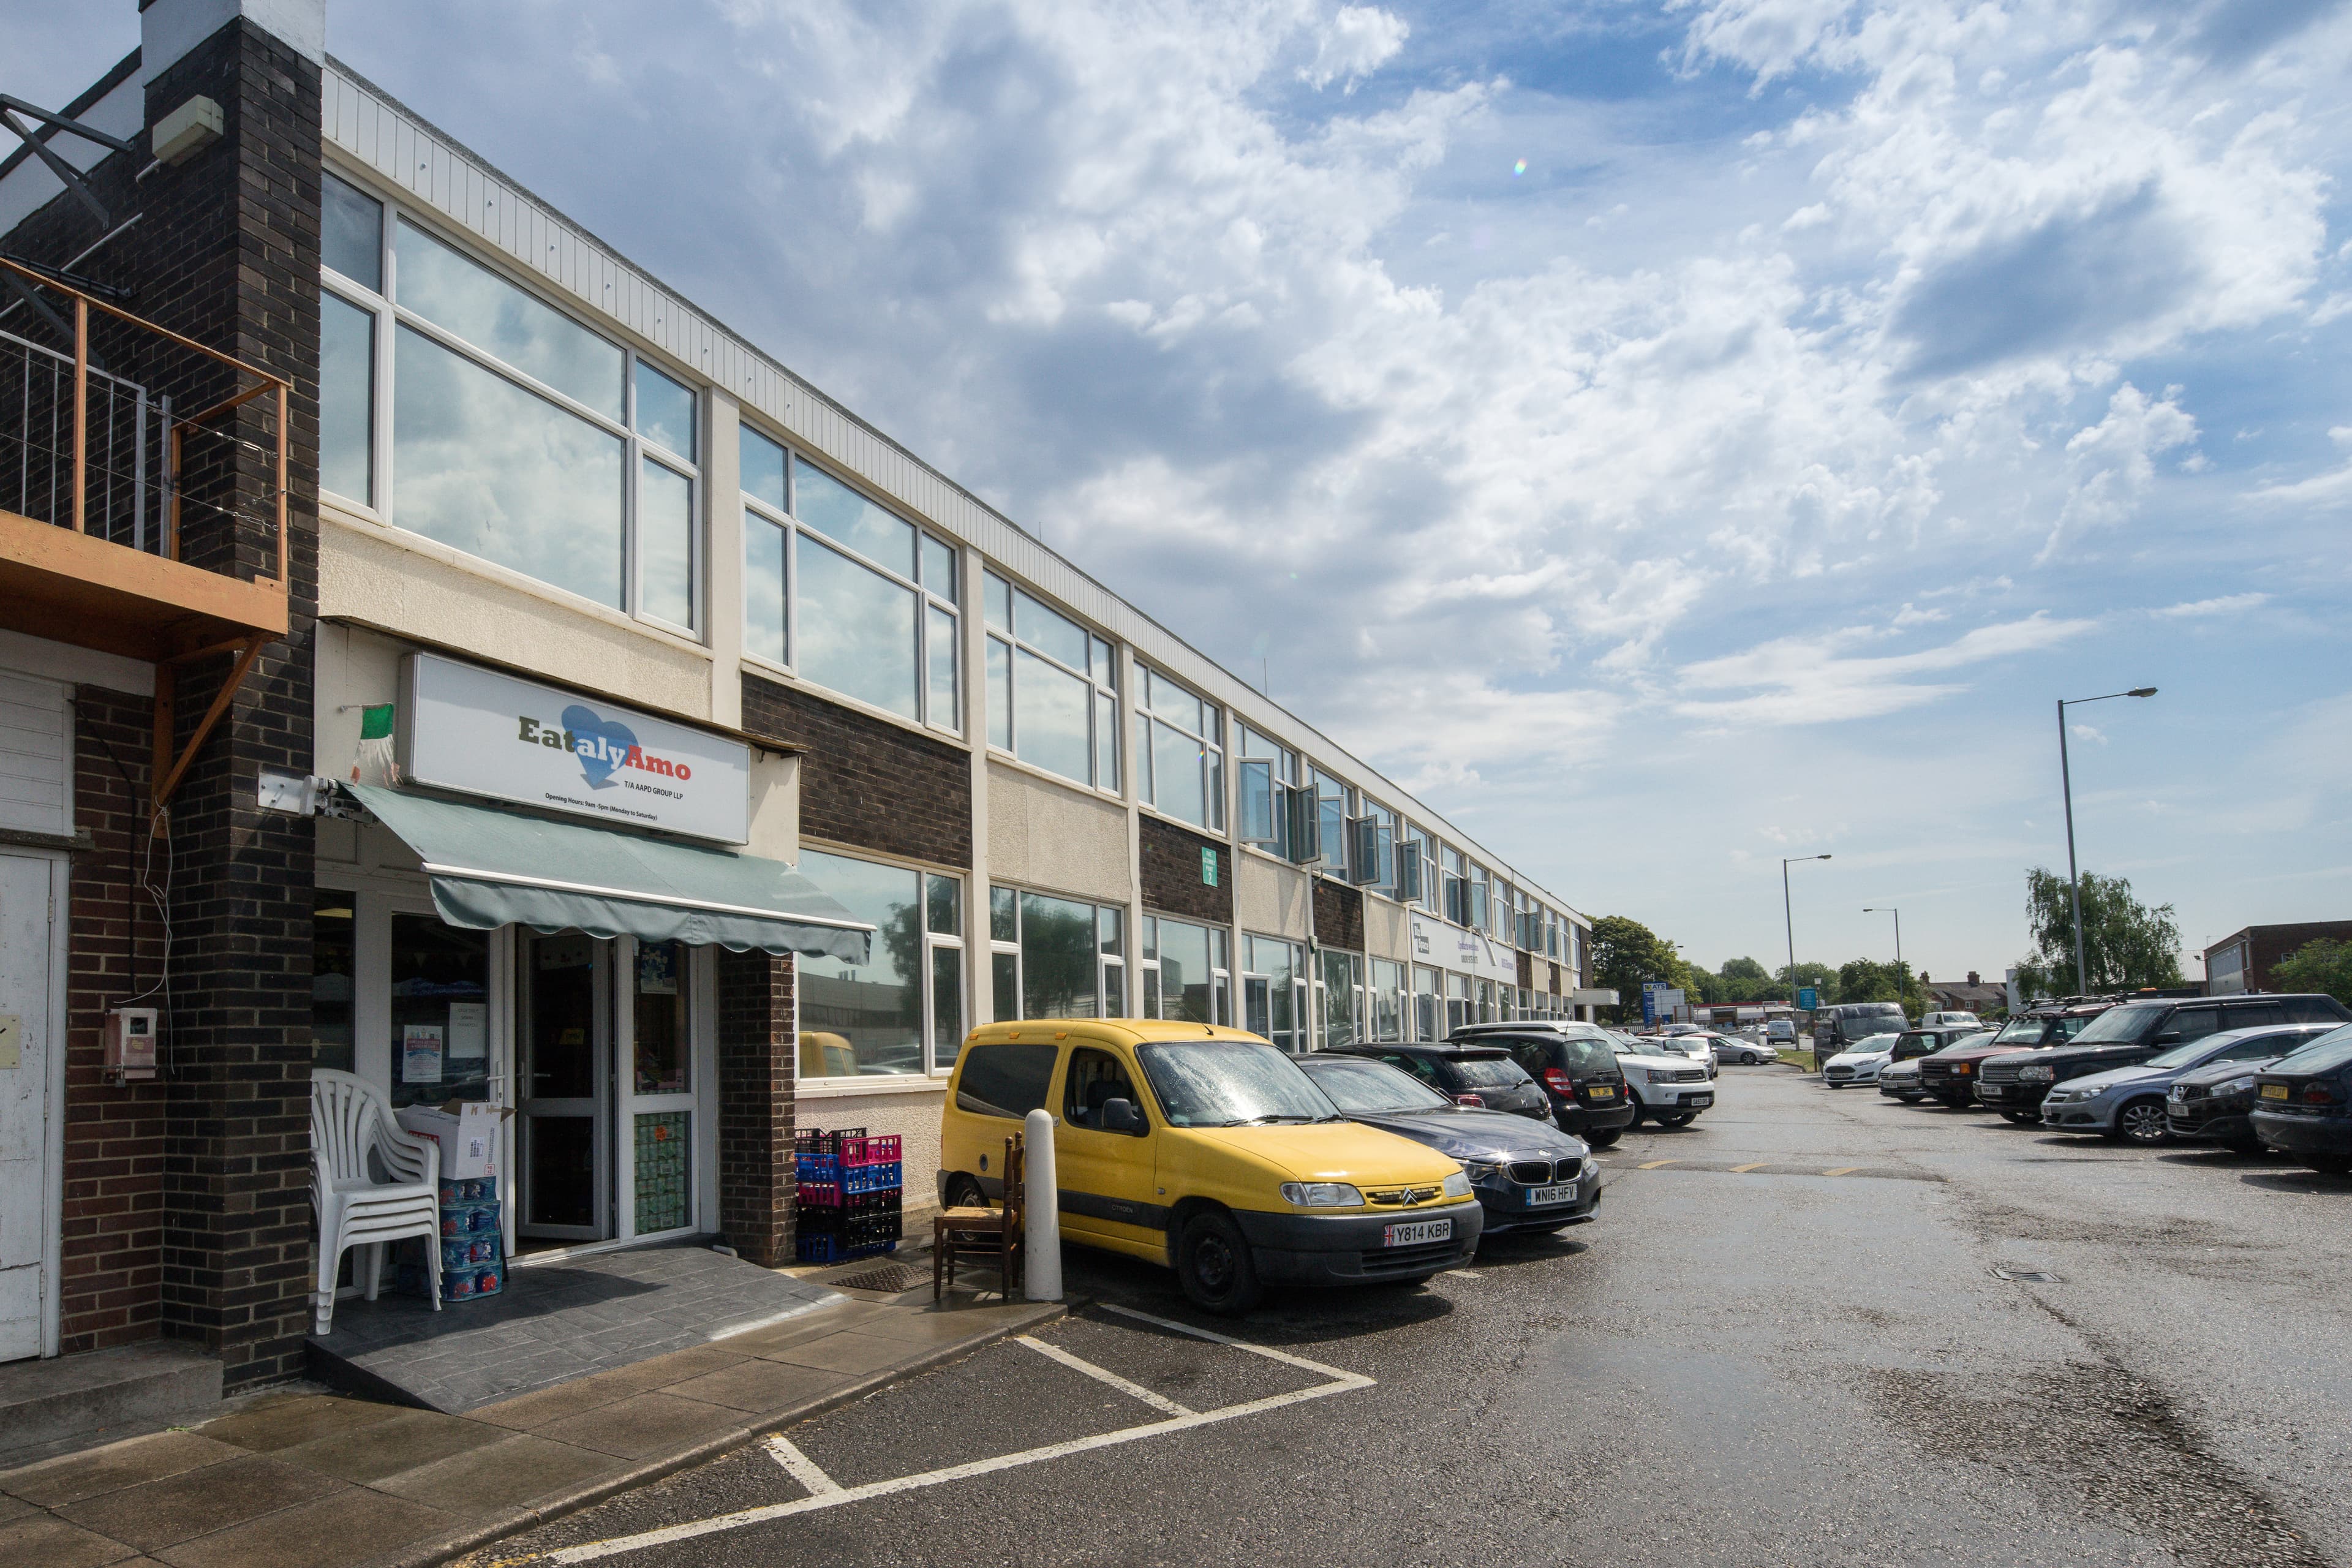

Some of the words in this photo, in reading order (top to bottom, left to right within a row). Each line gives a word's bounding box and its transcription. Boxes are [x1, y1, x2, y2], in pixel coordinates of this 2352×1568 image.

[519, 715, 691, 780] EatalyAmo
[624, 780, 635, 790] T/A
[636, 783, 652, 793] AAPD
[652, 787, 673, 797] GROUP
[545, 793, 567, 803] Opening
[568, 797, 584, 805] Hours:
[609, 805, 630, 816] (Monday
[636, 811, 657, 821] Saturday)
[1202, 857, 1216, 865] ASSEMBLY
[1208, 872, 1212, 884] 2
[1418, 938, 1429, 951] Space
[1535, 1188, 1555, 1203] WN16
[1558, 1185, 1575, 1201] HFV
[1396, 1226, 1424, 1243] Y814
[1427, 1222, 1449, 1240] KBR
